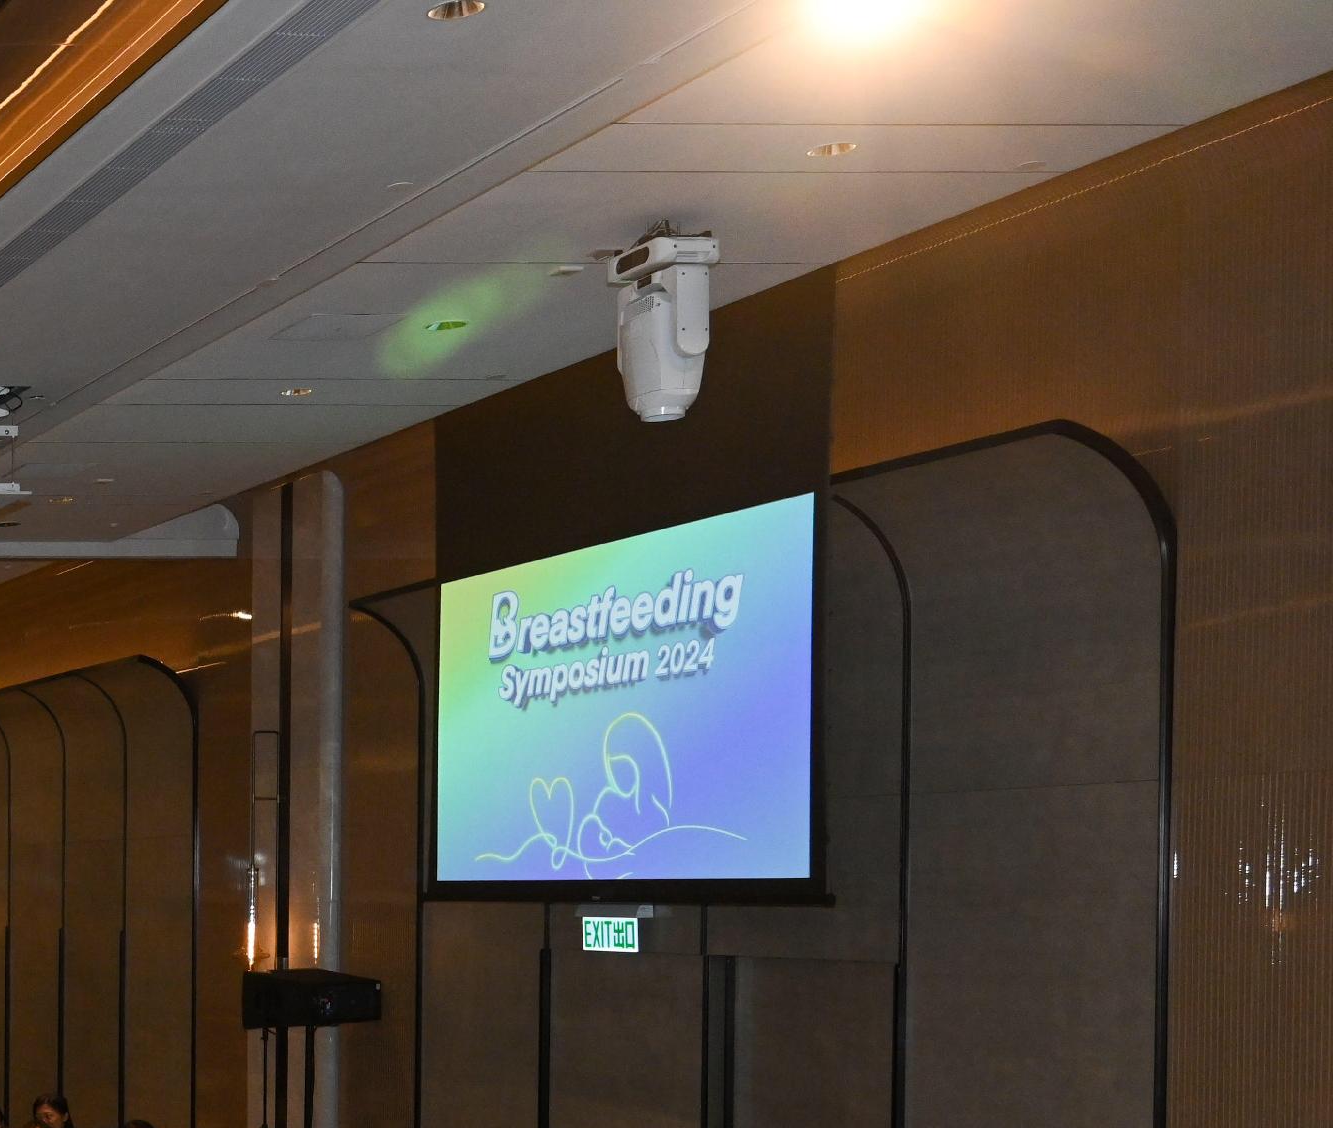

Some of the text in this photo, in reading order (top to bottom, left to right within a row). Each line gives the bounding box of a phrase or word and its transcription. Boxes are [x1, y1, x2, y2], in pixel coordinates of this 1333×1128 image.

[489, 568, 744, 661] Breastfeeding
[499, 637, 716, 708] Symposium 2024
[584, 920, 635, 949] EXIT 出口
